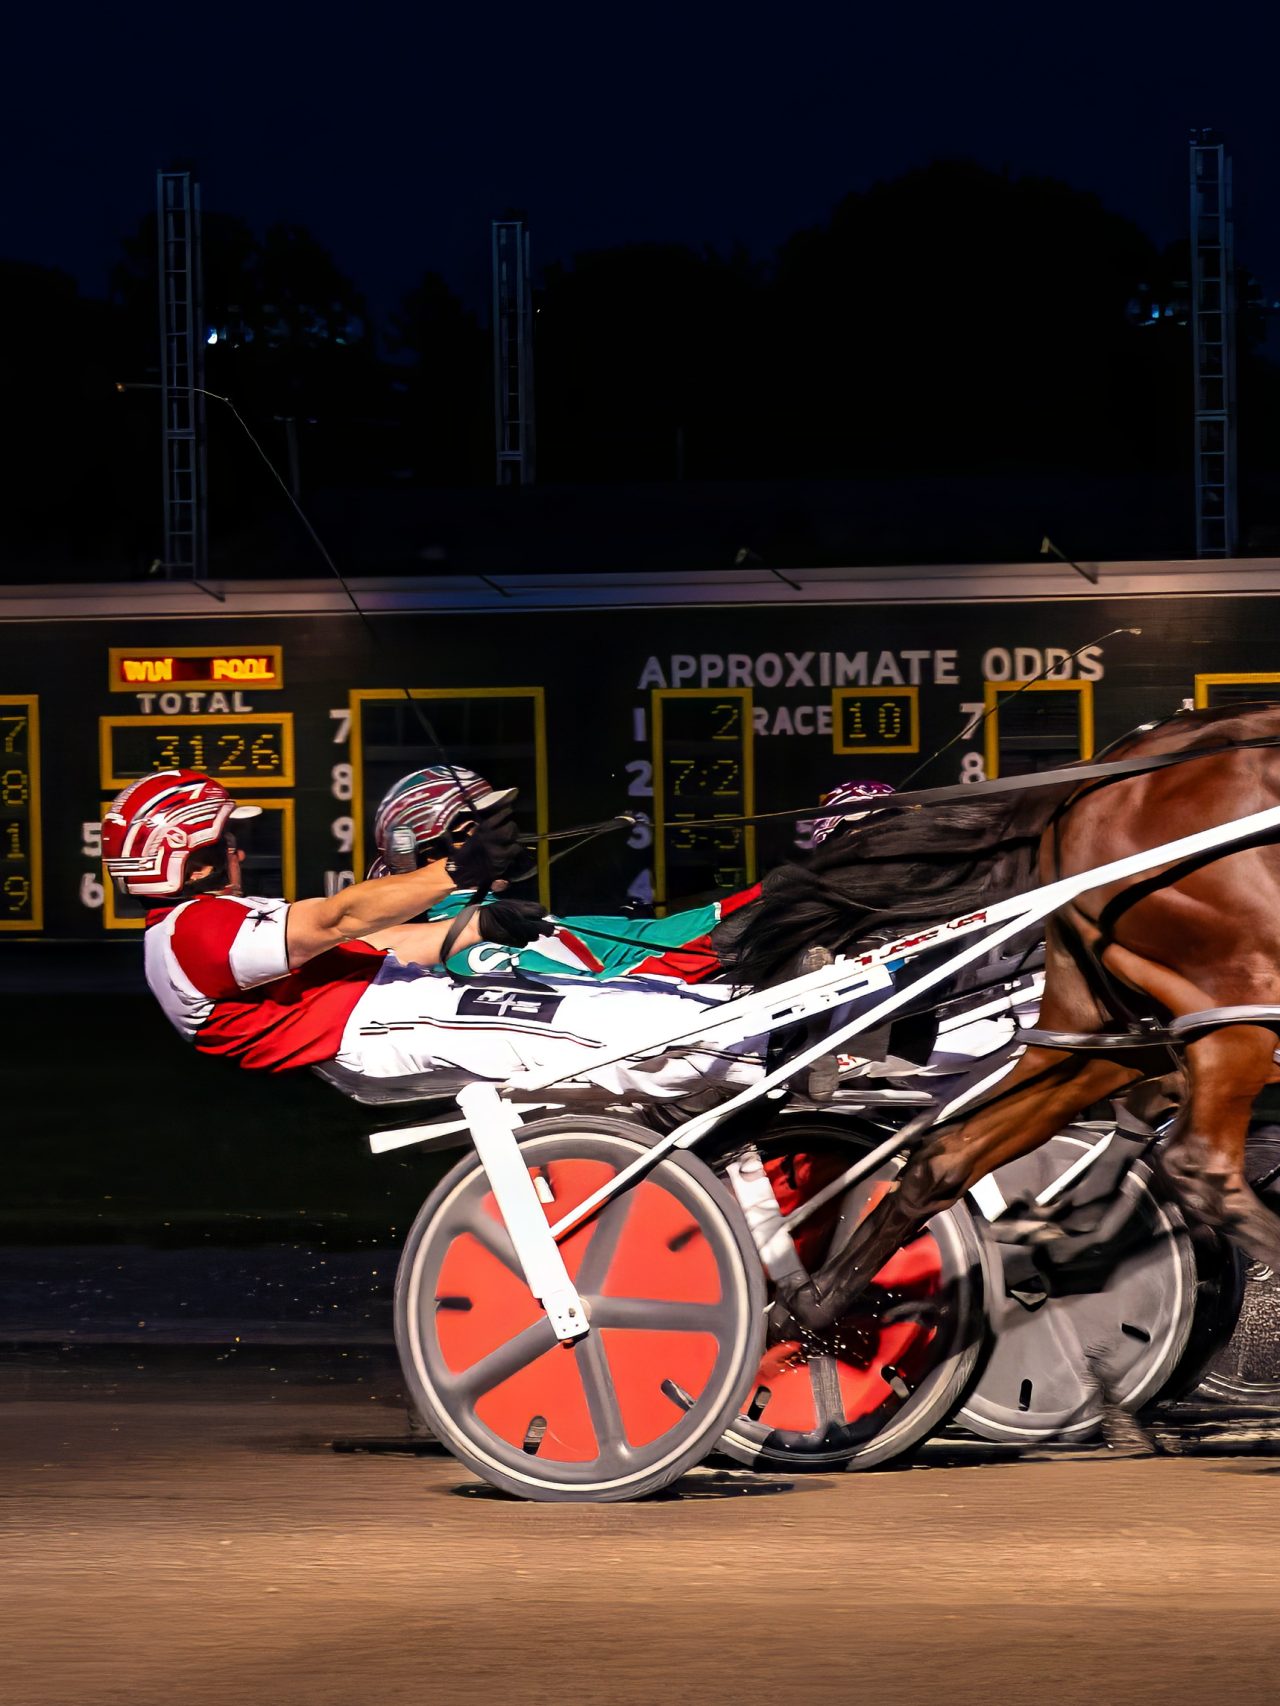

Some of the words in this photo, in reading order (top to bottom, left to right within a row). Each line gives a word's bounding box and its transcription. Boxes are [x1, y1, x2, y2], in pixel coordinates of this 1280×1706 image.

[212, 658, 275, 680] POOL
[637, 652, 959, 689] APPROXIMATE
[983, 646, 1104, 682] ODDS
[136, 692, 253, 714] TOTAL
[849, 702, 900, 738] 10
[329, 709, 354, 743] 7
[633, 707, 648, 741] 1
[711, 705, 739, 739] 2
[752, 706, 832, 736] RACE
[960, 703, 986, 740] 7
[153, 734, 279, 770] 3126
[960, 752, 987, 784] 8
[331, 763, 354, 800] 8
[625, 760, 654, 796] 2
[81, 822, 102, 857] 5
[331, 816, 356, 853] 9
[80, 873, 104, 908] 6
